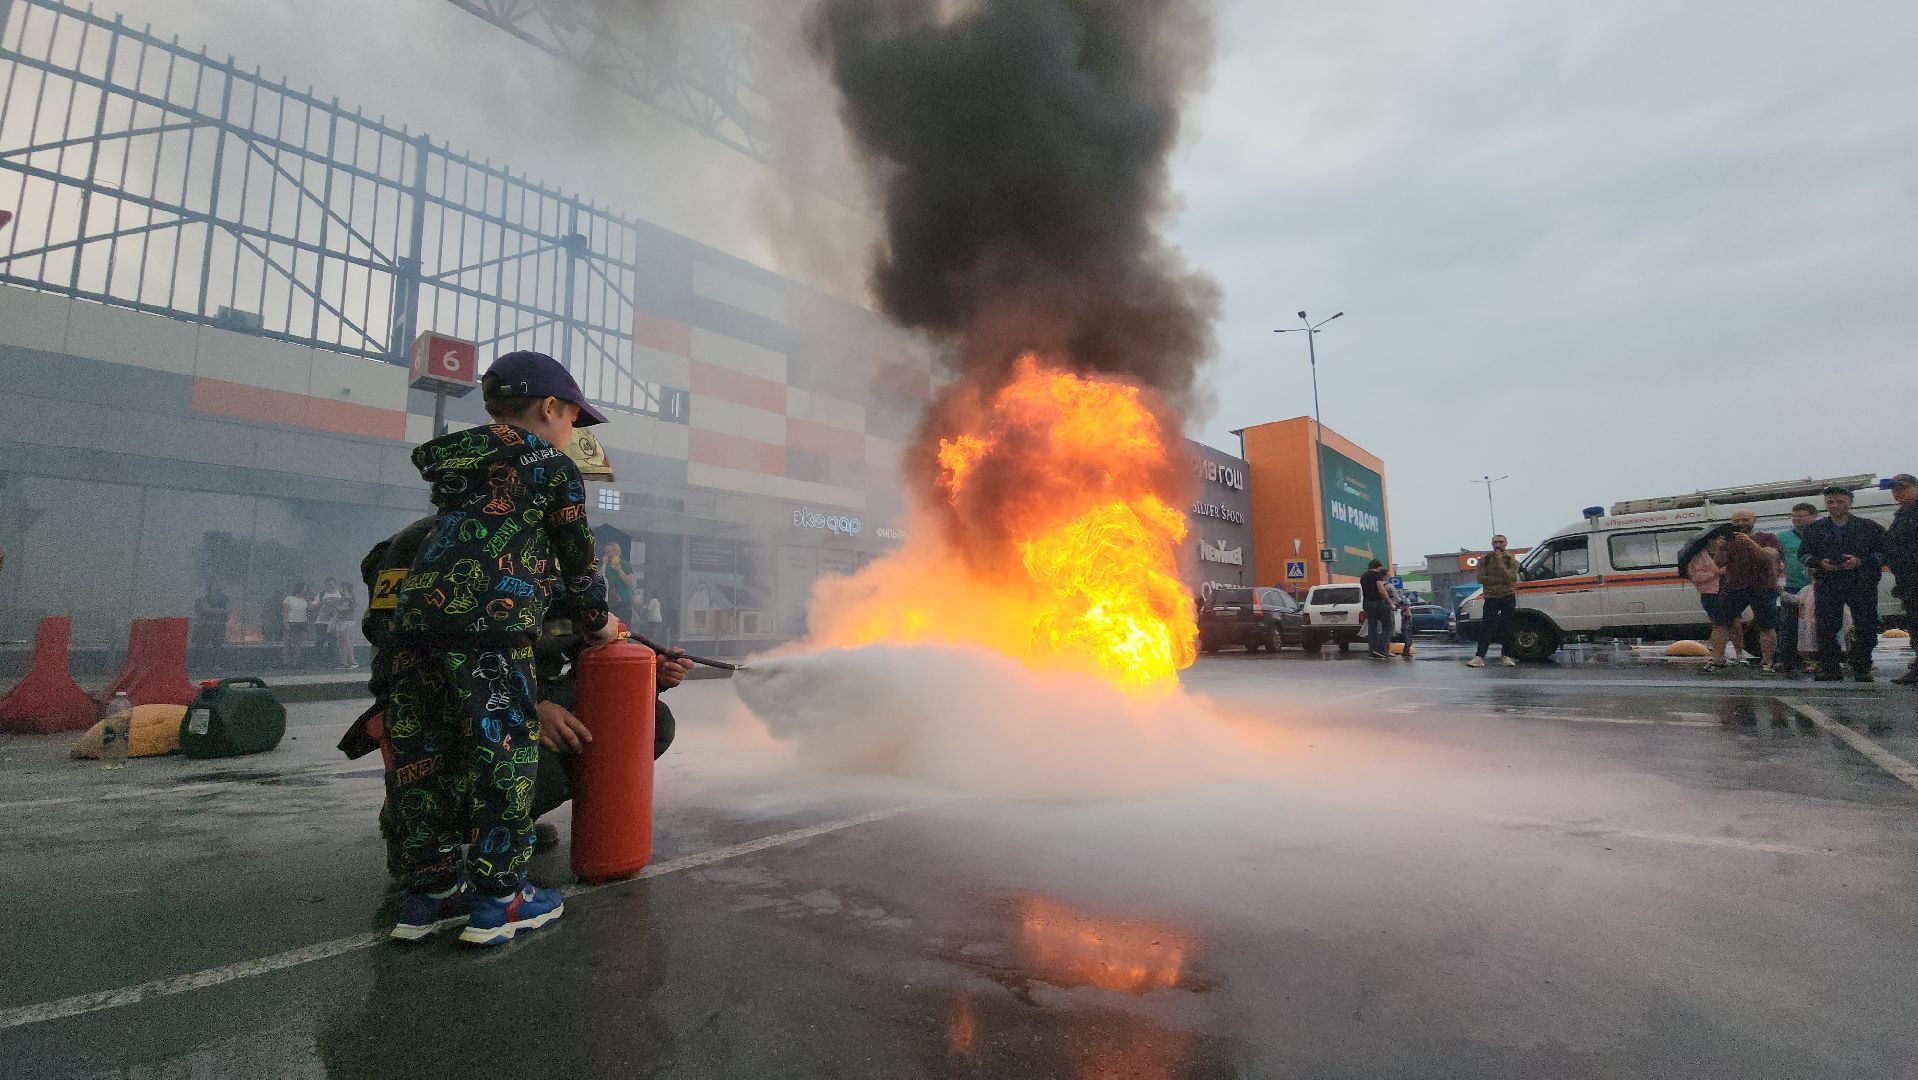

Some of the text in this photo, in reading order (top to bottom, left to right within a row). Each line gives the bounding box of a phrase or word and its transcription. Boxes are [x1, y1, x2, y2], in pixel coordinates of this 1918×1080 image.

[443, 350, 460, 371] 6
[1192, 501, 1220, 519] SILVER
[1331, 499, 1347, 522] МЫ
